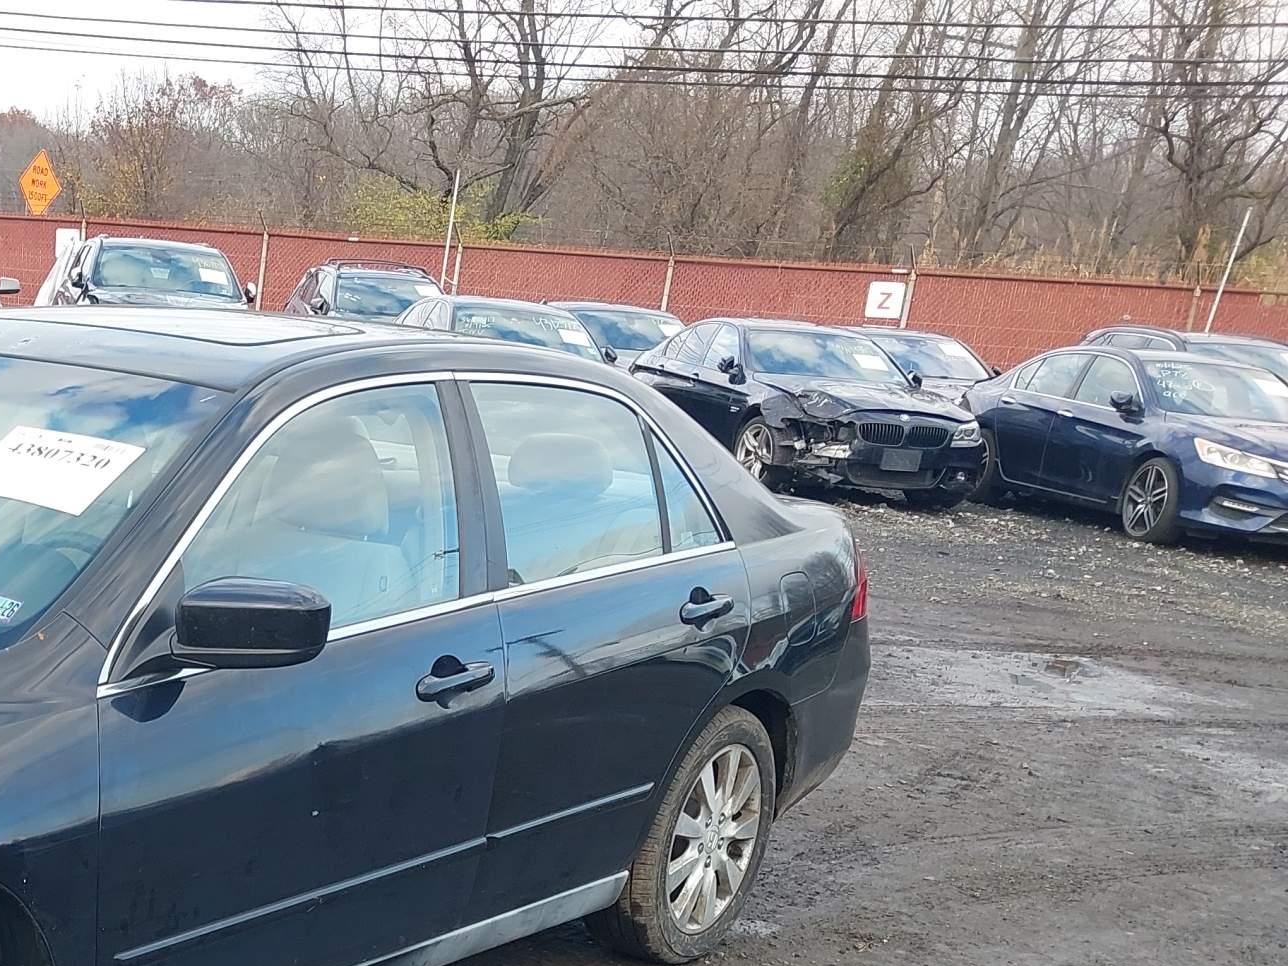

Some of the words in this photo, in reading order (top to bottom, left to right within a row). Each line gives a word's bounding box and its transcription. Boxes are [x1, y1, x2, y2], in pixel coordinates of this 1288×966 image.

[32, 165, 49, 176] ROAD
[31, 178, 47, 189] WORK
[877, 292, 892, 309] Z
[8, 443, 111, 469] 43807320
